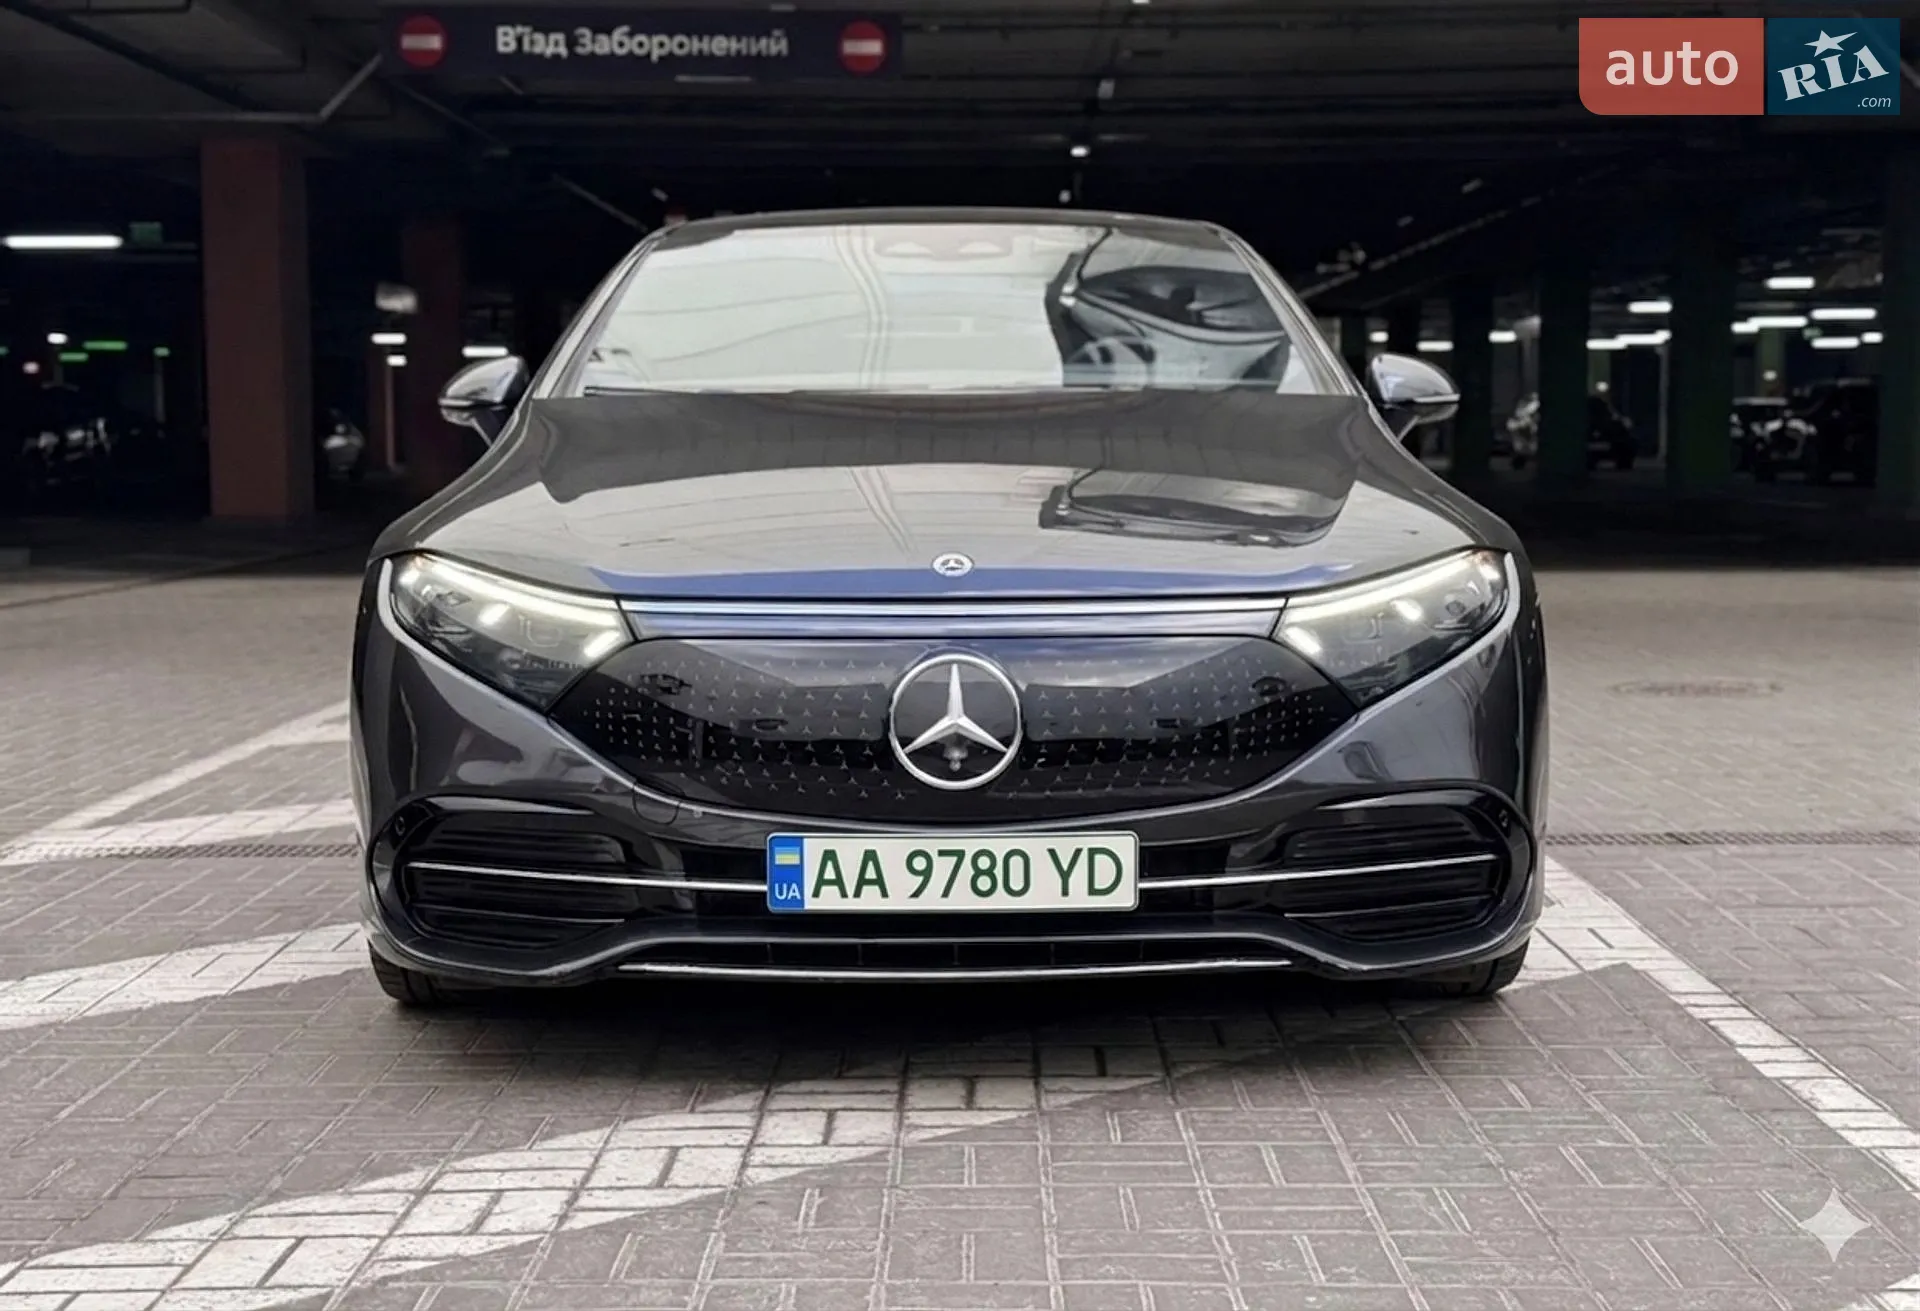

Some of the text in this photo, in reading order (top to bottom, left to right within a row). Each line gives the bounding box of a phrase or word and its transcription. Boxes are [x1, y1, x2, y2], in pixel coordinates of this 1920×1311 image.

[574, 25, 789, 63] Заборонений
[774, 883, 801, 900] UA
[811, 847, 1123, 899] AA 9780 YD
